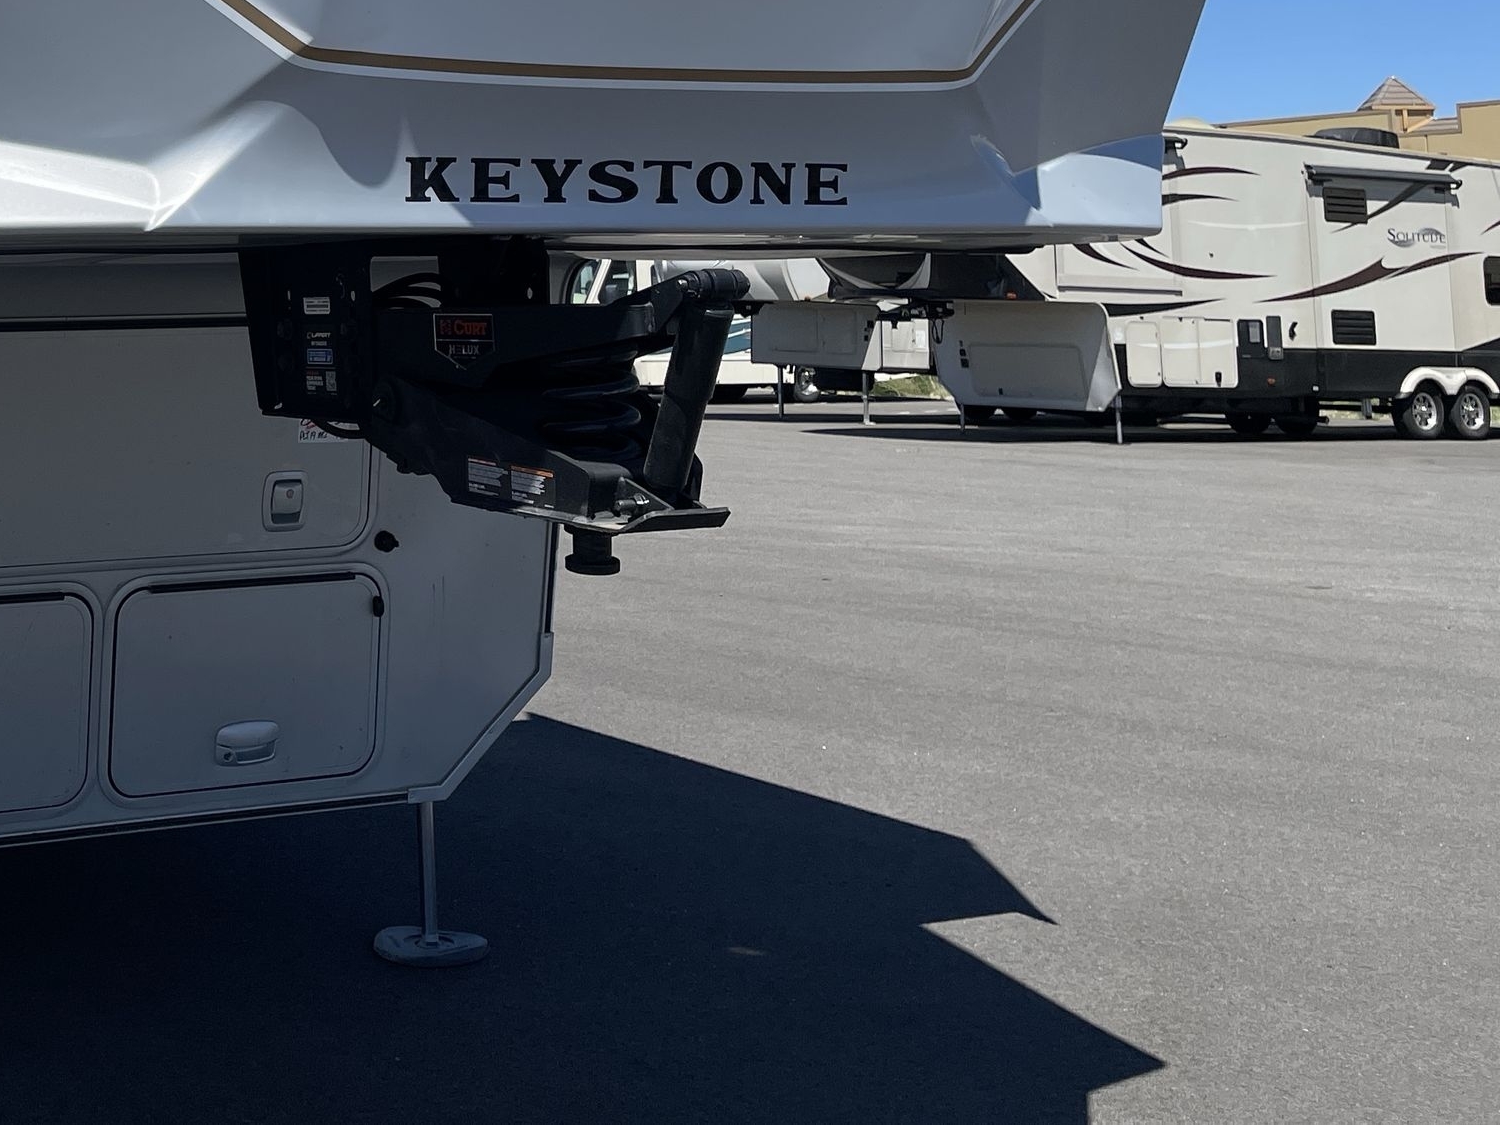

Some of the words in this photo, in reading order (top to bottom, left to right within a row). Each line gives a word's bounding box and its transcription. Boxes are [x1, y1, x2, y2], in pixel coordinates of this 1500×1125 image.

[404, 156, 849, 206] KEYSTONE
[1387, 228, 1446, 243] SOLITUDE
[454, 319, 488, 336] CURT
